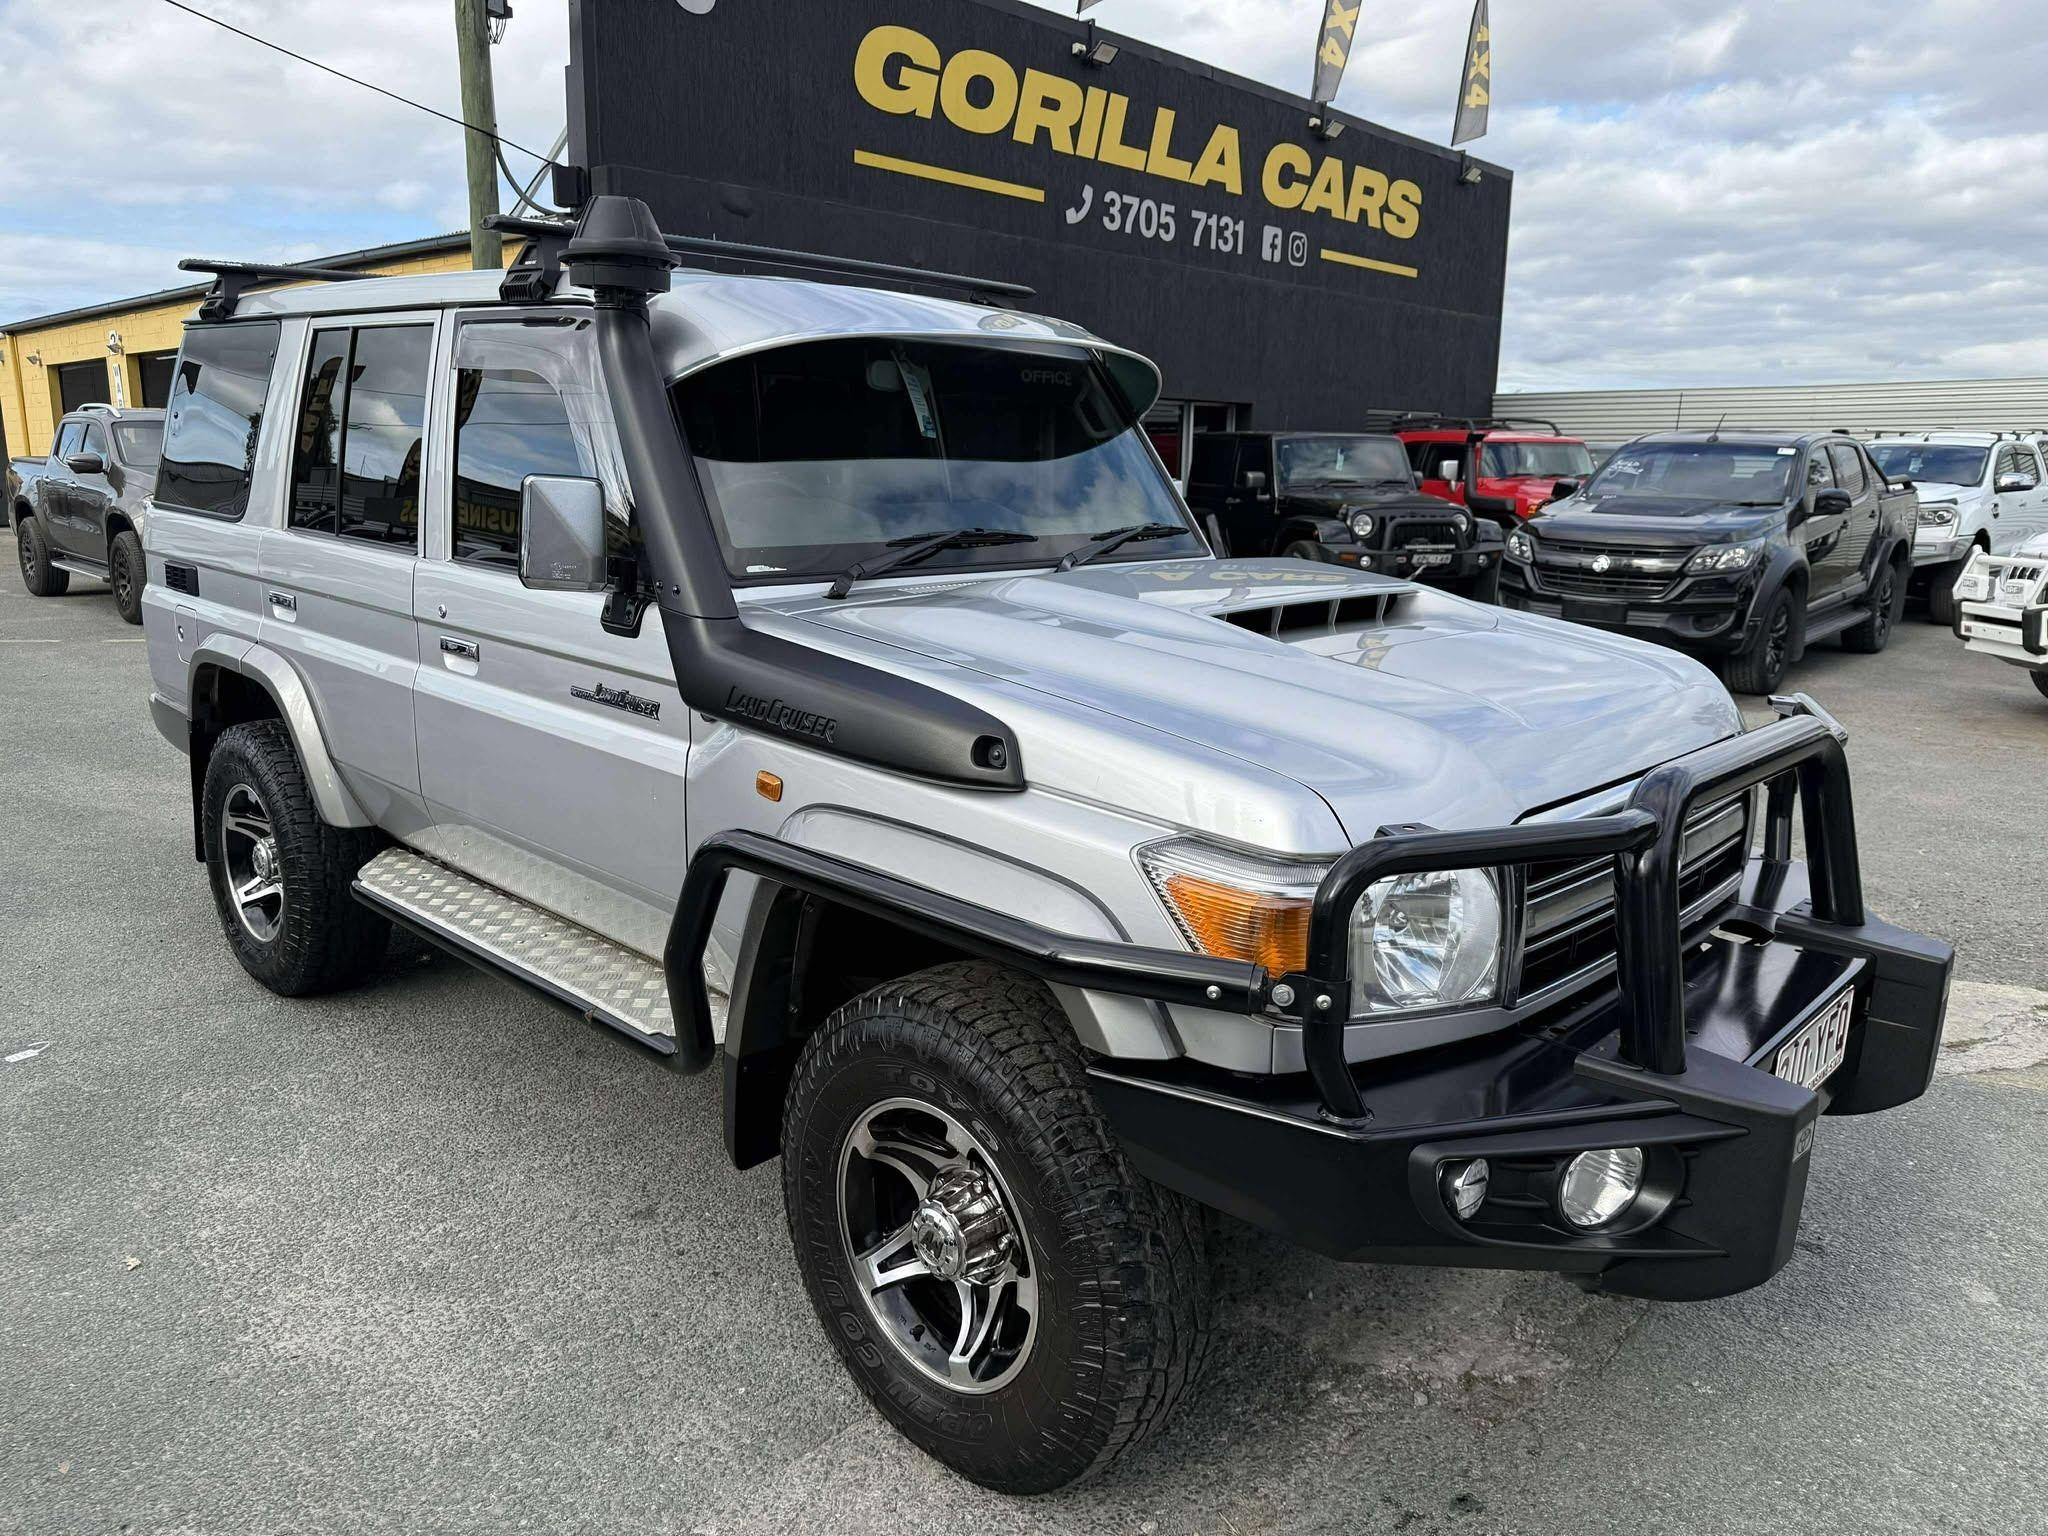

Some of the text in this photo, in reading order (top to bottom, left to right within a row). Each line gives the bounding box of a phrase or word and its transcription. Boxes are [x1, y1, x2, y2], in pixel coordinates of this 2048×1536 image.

[854, 25, 1422, 238] GORILLA CARS
[1102, 190, 1244, 255] 3705 7131
[1021, 369, 1073, 387] OFFICE
